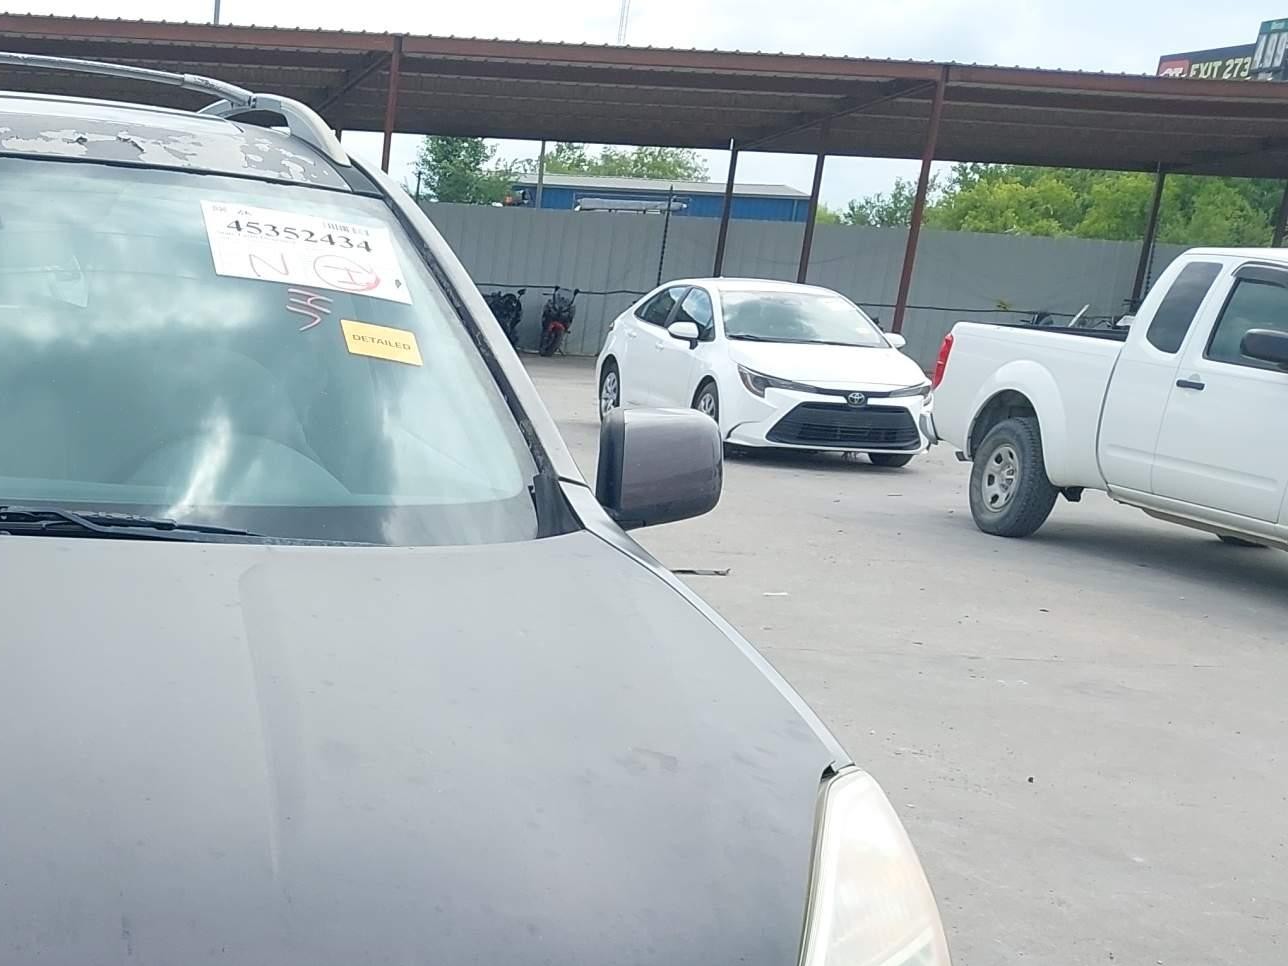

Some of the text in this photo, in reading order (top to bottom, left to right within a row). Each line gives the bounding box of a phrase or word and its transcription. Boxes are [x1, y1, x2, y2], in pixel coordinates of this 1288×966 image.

[1190, 61, 1222, 78] EXIT
[1222, 56, 1251, 79] 273
[226, 219, 372, 253] 45352434
[352, 334, 411, 351] DETAILED
